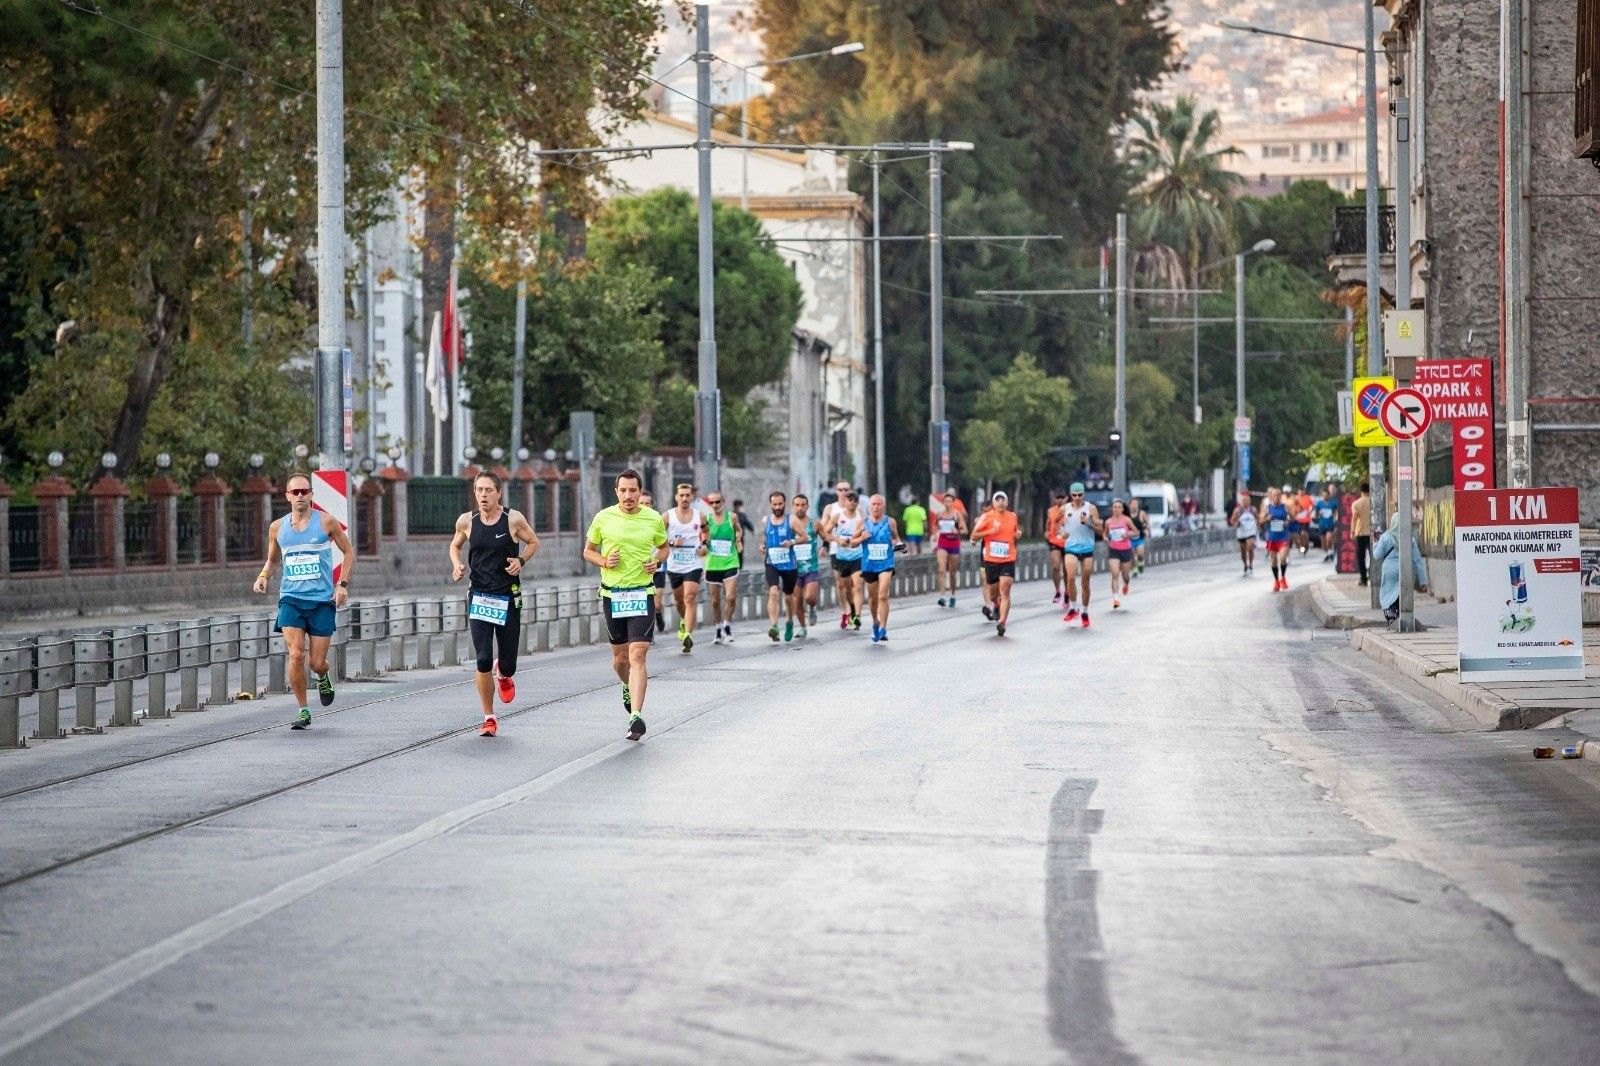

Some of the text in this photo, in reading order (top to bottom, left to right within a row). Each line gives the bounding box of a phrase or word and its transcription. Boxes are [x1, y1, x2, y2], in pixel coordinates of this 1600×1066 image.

[1453, 363, 1483, 378] CAR
[1410, 381, 1482, 398] TOPARK &
[1432, 402, 1489, 418] YIKAMA
[1487, 494, 1548, 521] 1 KM
[1462, 528, 1573, 542] MARATONDA KİLOMETRELERE
[1474, 543, 1562, 554] MEYDAN OKUMAK MI?
[287, 563, 320, 575] 10330
[472, 604, 506, 619] 10337
[612, 600, 646, 612] 10270
